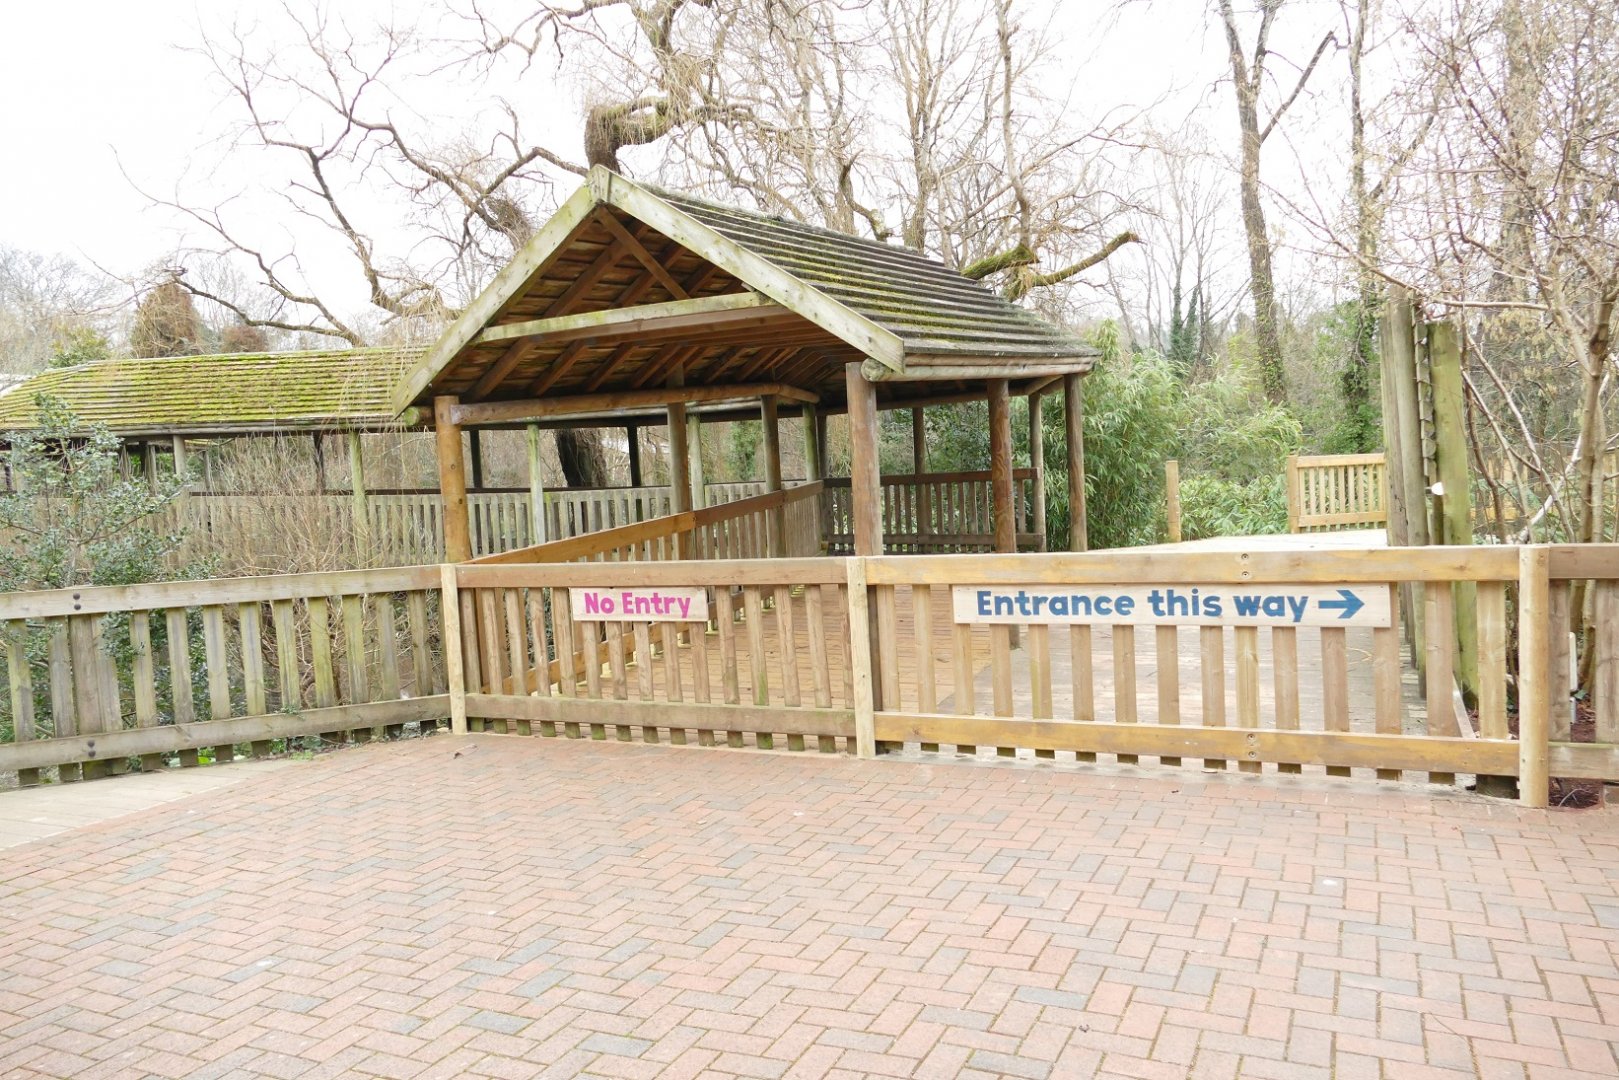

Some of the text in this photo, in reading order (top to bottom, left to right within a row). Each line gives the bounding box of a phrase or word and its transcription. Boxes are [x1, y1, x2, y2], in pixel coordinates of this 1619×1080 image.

[584, 592, 691, 618] No Entry
[977, 588, 1309, 622] Entrance this way
